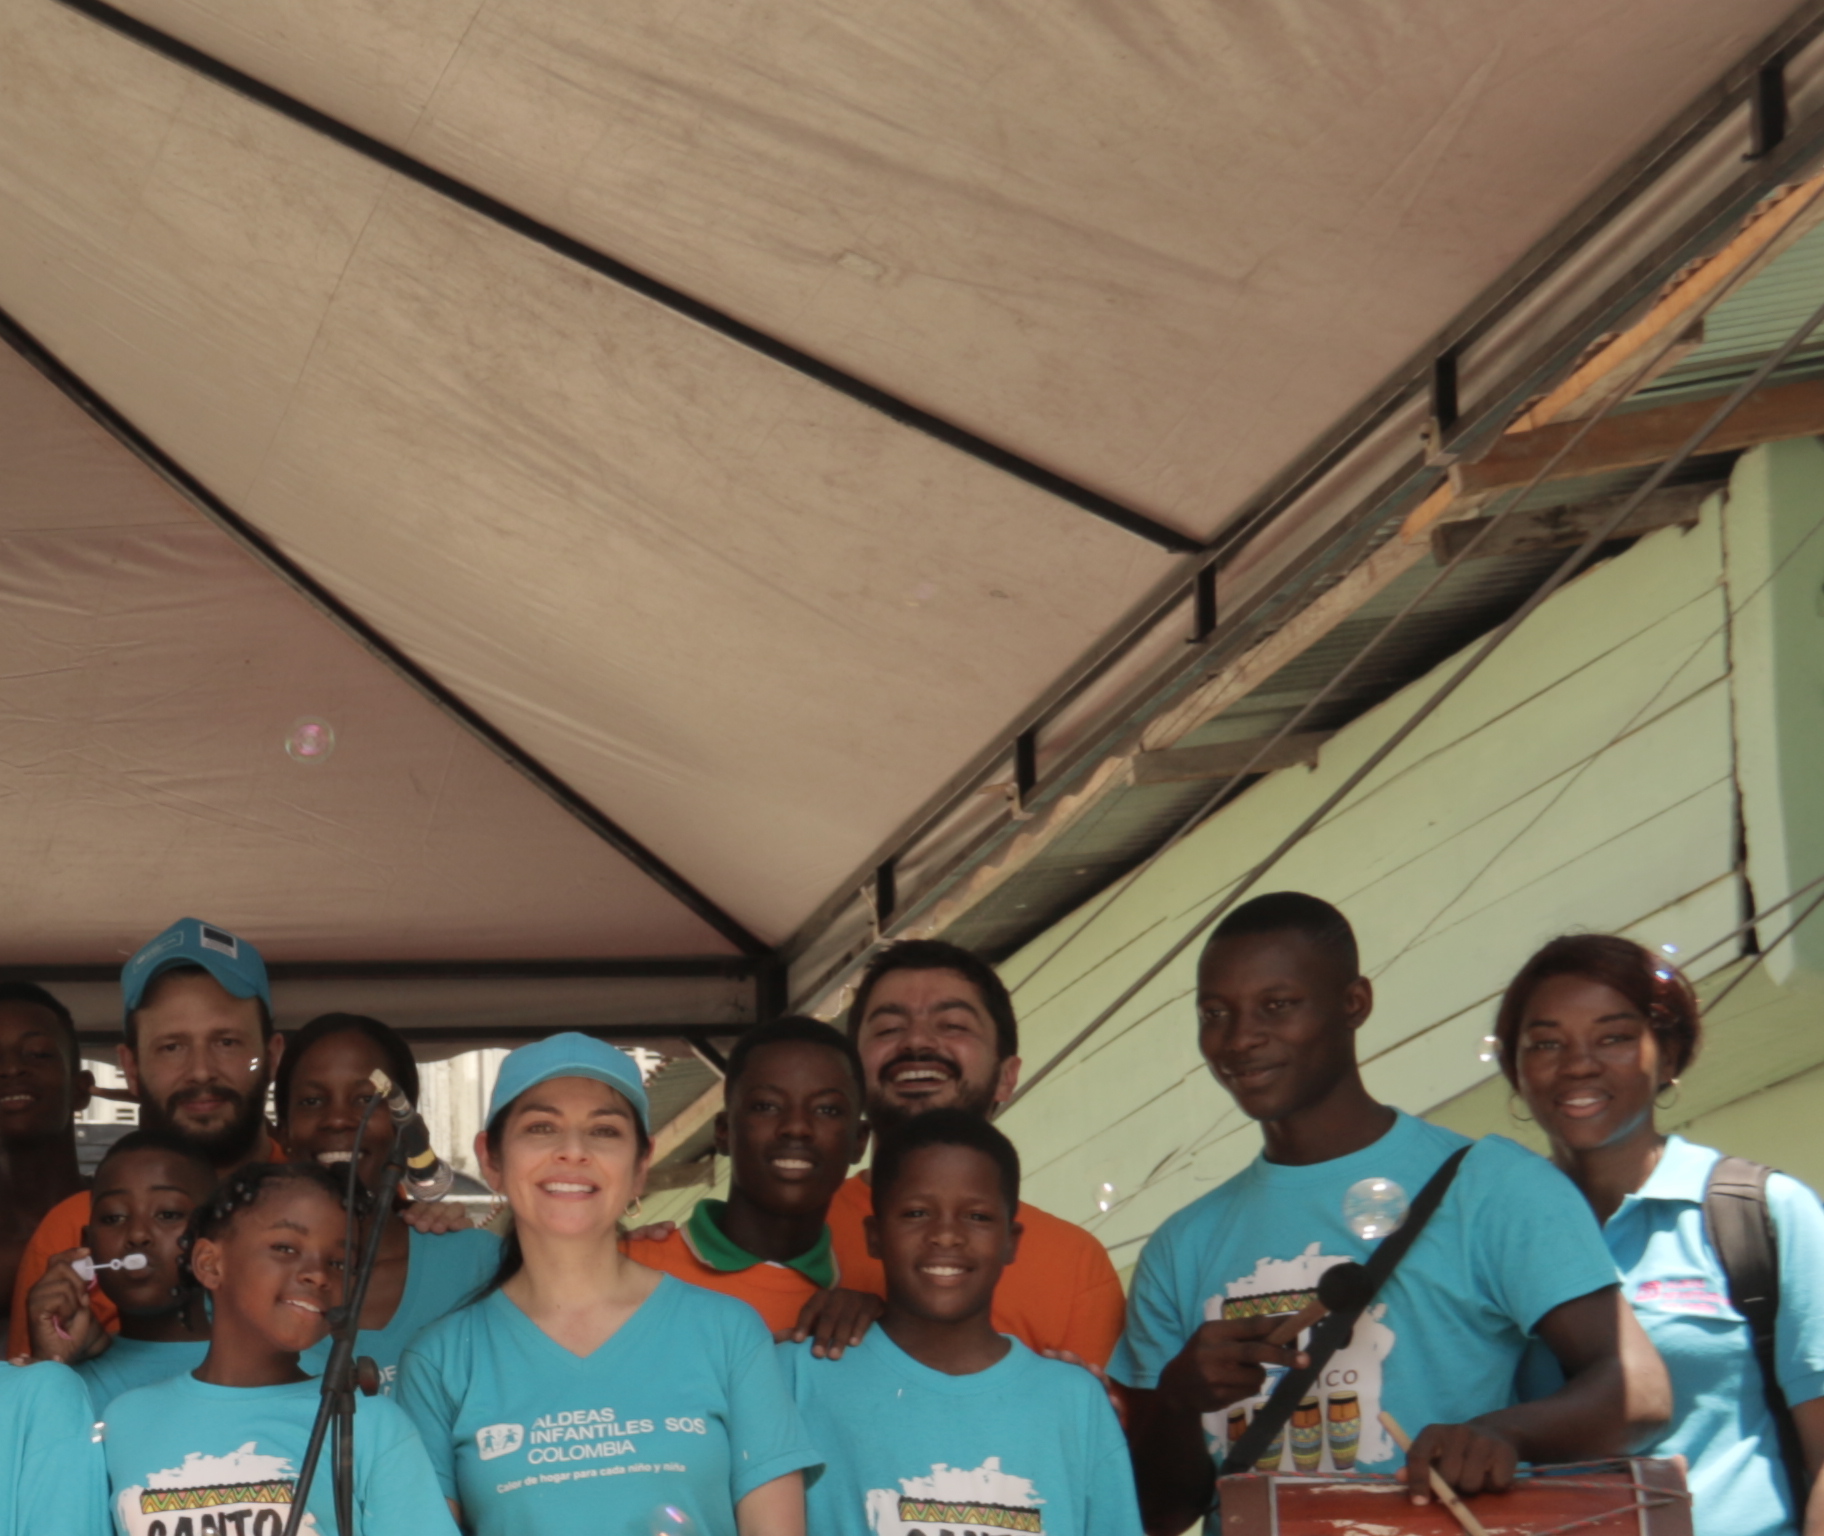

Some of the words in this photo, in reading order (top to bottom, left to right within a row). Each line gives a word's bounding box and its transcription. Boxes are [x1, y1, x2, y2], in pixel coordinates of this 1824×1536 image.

[532, 1407, 615, 1429] ALDEAS
[530, 1418, 655, 1445] INFANTILES
[664, 1417, 707, 1435] SOS
[527, 1439, 636, 1465] COLOMBIA
[523, 1476, 538, 1486] de
[539, 1470, 571, 1484] hogar
[573, 1467, 598, 1481] para
[599, 1464, 626, 1477] cada
[653, 1463, 660, 1474] y
